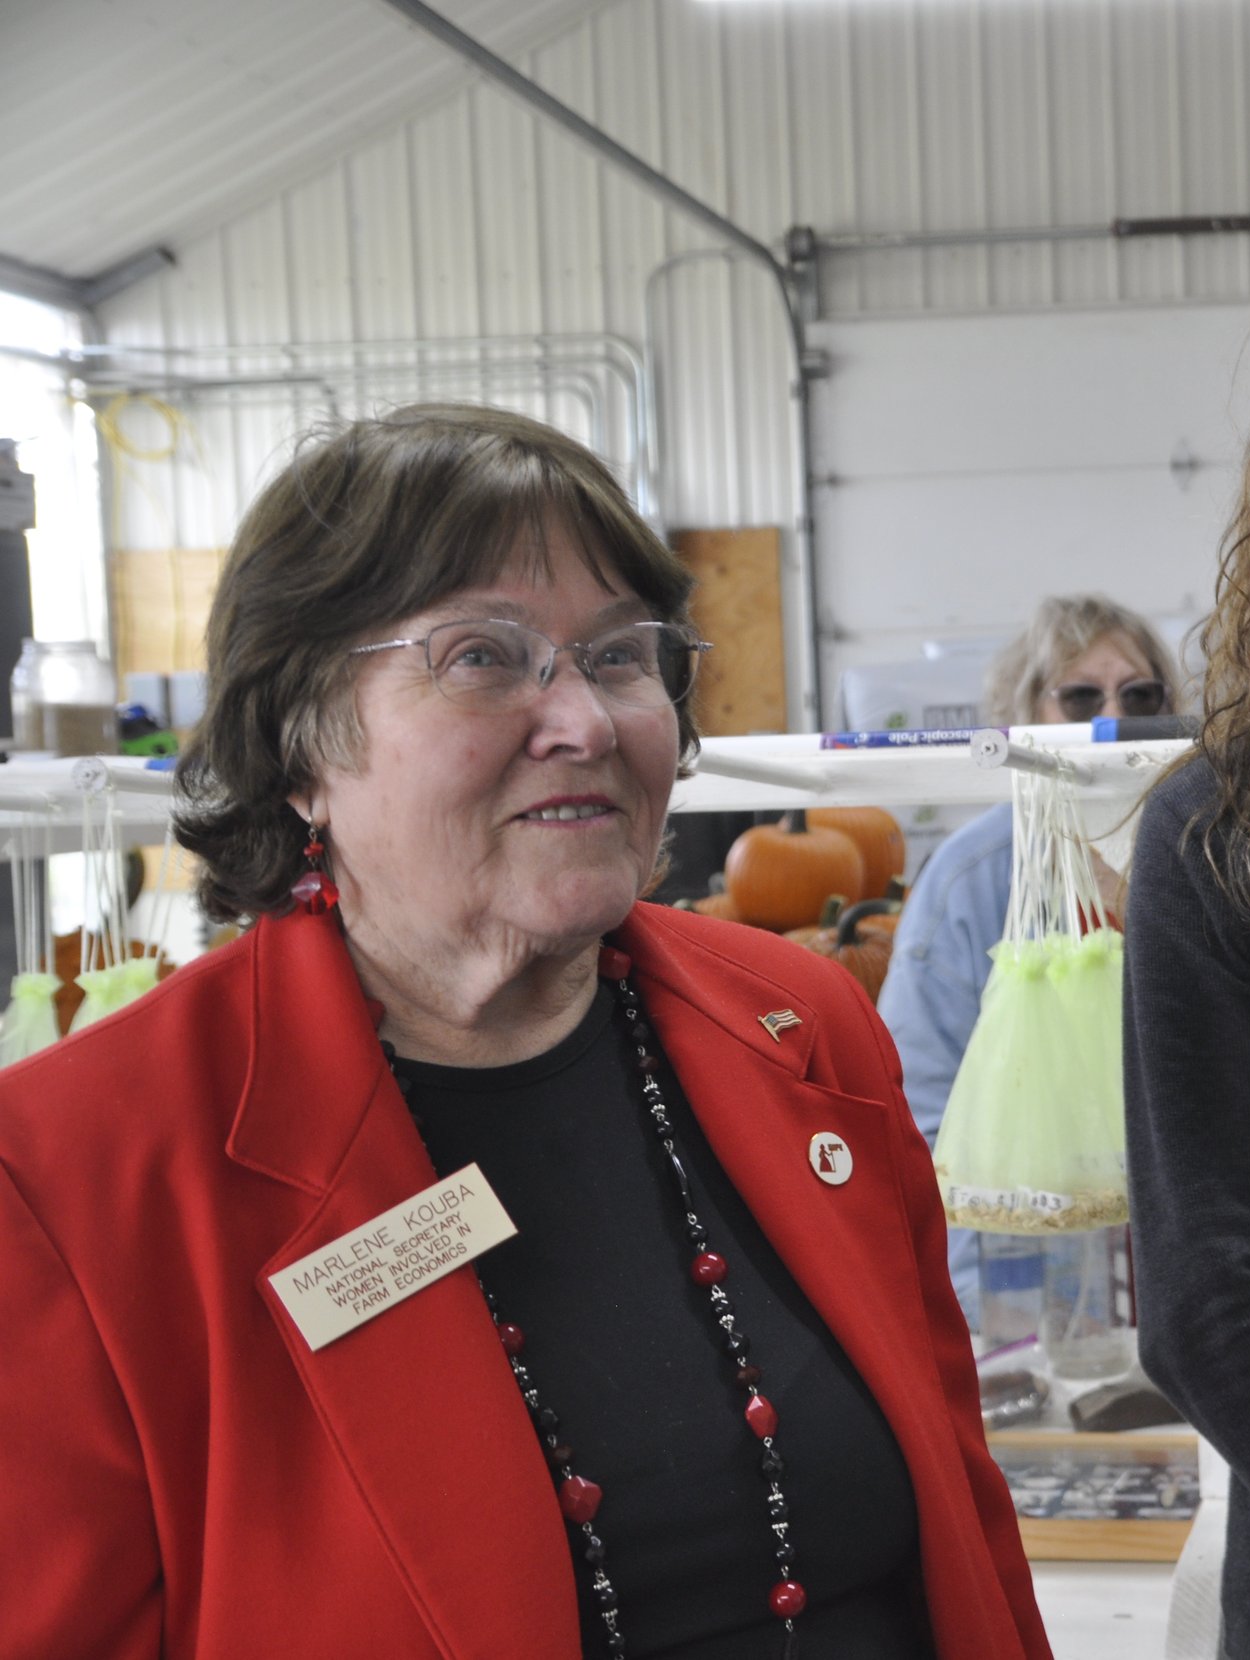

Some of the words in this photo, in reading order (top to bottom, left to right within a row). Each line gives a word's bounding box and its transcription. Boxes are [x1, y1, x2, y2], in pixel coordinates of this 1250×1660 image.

[888, 731, 919, 744] Pole
[292, 1226, 395, 1295] MARLENE
[402, 1183, 475, 1231] KOUBA
[325, 1256, 389, 1296] NATIONAL
[392, 1212, 463, 1258] SECRETARY
[332, 1274, 384, 1308] WOMEN
[388, 1234, 451, 1277] INVOLVED
[456, 1222, 472, 1238] IN
[352, 1288, 391, 1316] FARM
[394, 1242, 468, 1290] ECONOMICS
